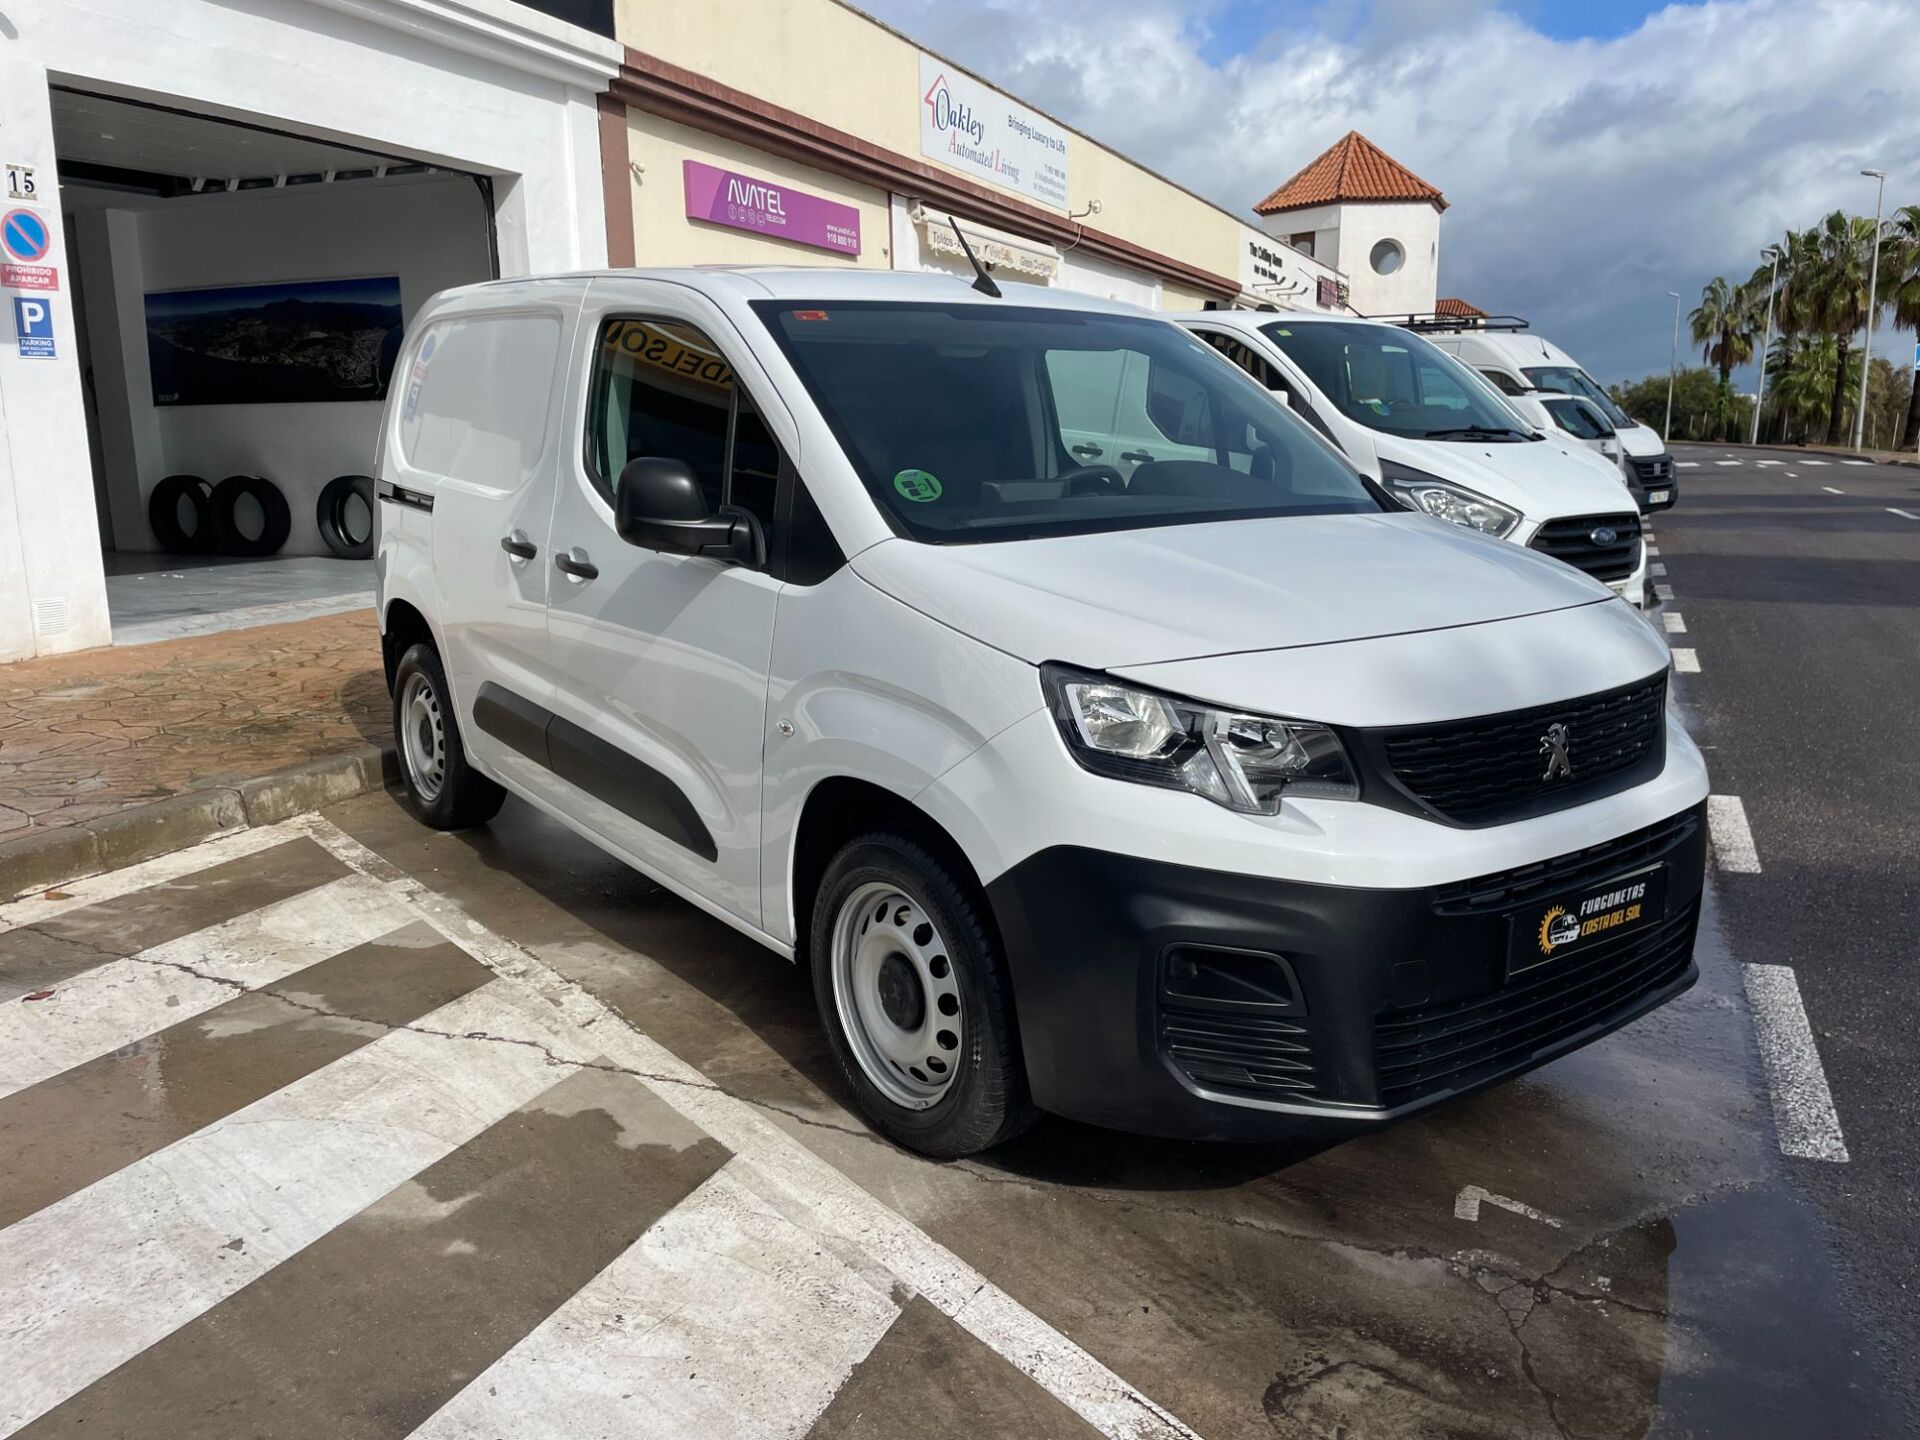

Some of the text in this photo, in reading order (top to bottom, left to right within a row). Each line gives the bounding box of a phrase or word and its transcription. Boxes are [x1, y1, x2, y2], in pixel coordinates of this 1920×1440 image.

[936, 88, 984, 146] Oakley
[948, 129, 994, 169] Automated
[994, 148, 1020, 184] Living
[9, 170, 35, 193] 15
[728, 178, 786, 215] AVATEL
[5, 264, 52, 276] PROHIBIDO
[9, 273, 50, 285] APARCAR
[21, 301, 45, 334] P
[1580, 882, 1646, 917] FURGONETAS
